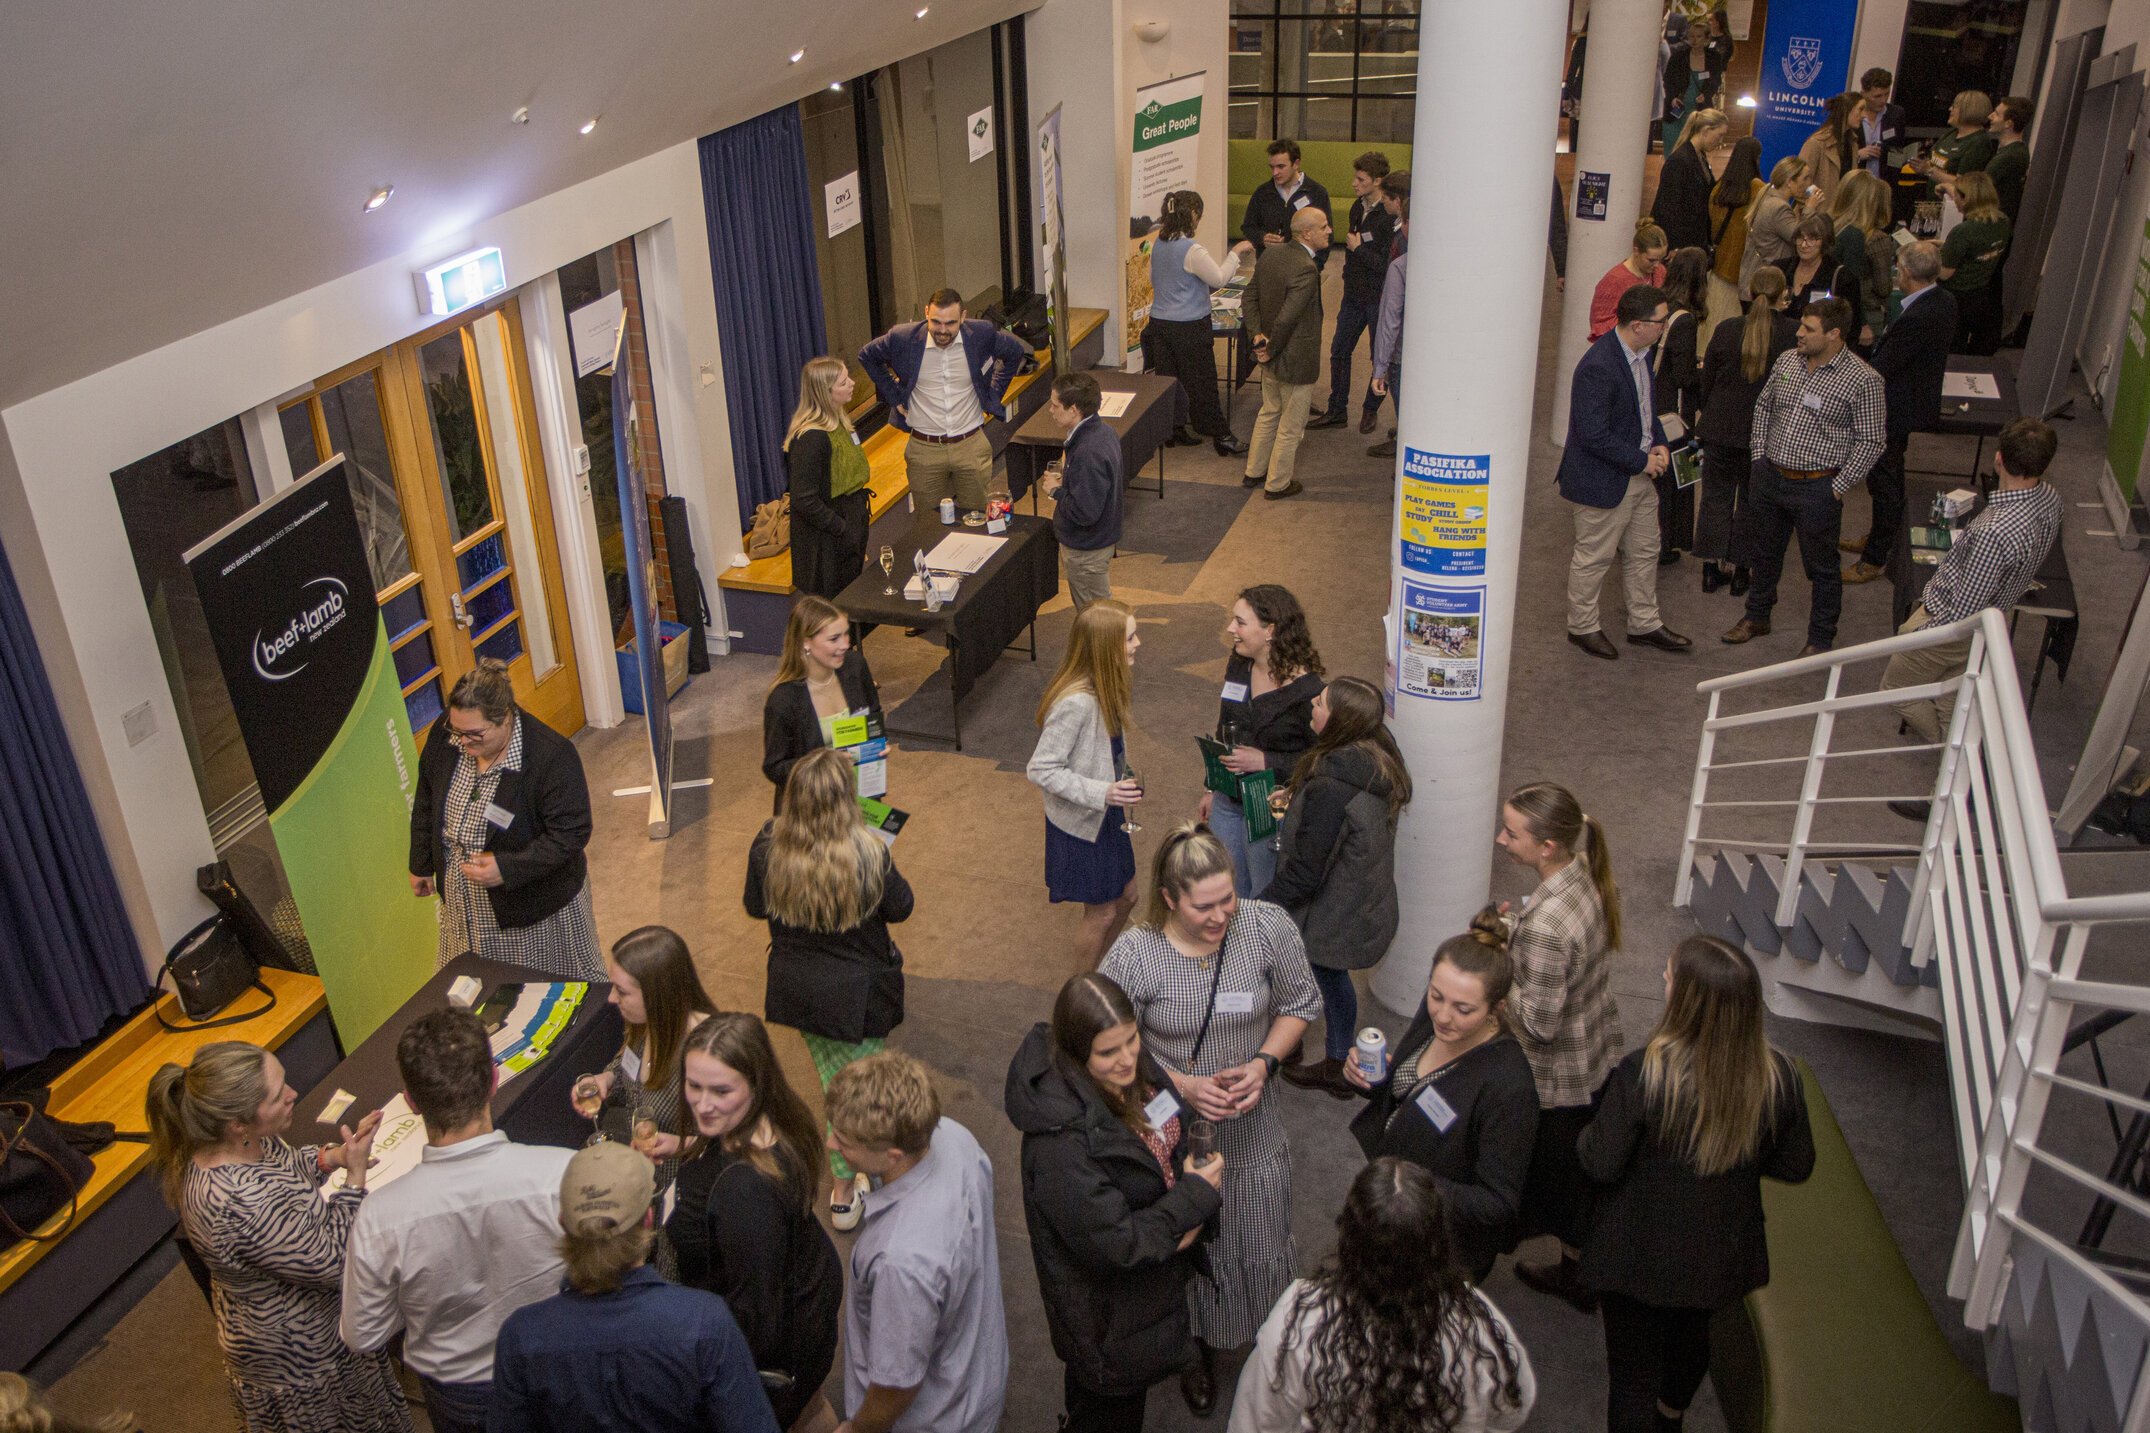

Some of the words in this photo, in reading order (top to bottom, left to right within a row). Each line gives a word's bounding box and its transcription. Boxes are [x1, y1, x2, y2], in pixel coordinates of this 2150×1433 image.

[1768, 91, 1825, 107] LINCOLN
[1147, 104, 1159, 115] FAR
[1775, 106, 1816, 116] UNIVERSITY
[1142, 122, 1166, 140] Great
[1168, 113, 1198, 133] People
[1413, 453, 1476, 469] PASIFIKA
[1405, 462, 1487, 479] ASSOCIATION
[1405, 494, 1423, 504] PLAY
[1425, 499, 1456, 508] GAMES
[1405, 512, 1433, 523] STUDY
[1429, 509, 1458, 518] CHILL
[1433, 526, 1458, 534] HANG
[222, 562, 236, 576] 0800
[235, 545, 261, 567] BEEFLAMB
[293, 501, 328, 527] beeflambnz.com
[1408, 544, 1424, 552] FOLLOW
[262, 591, 343, 665] beef+lamb
[309, 631, 323, 643] new
[322, 608, 346, 633] zealand
[1406, 683, 1429, 693] Come
[1440, 688, 1457, 696] Join
[386, 718, 410, 791] farmers
